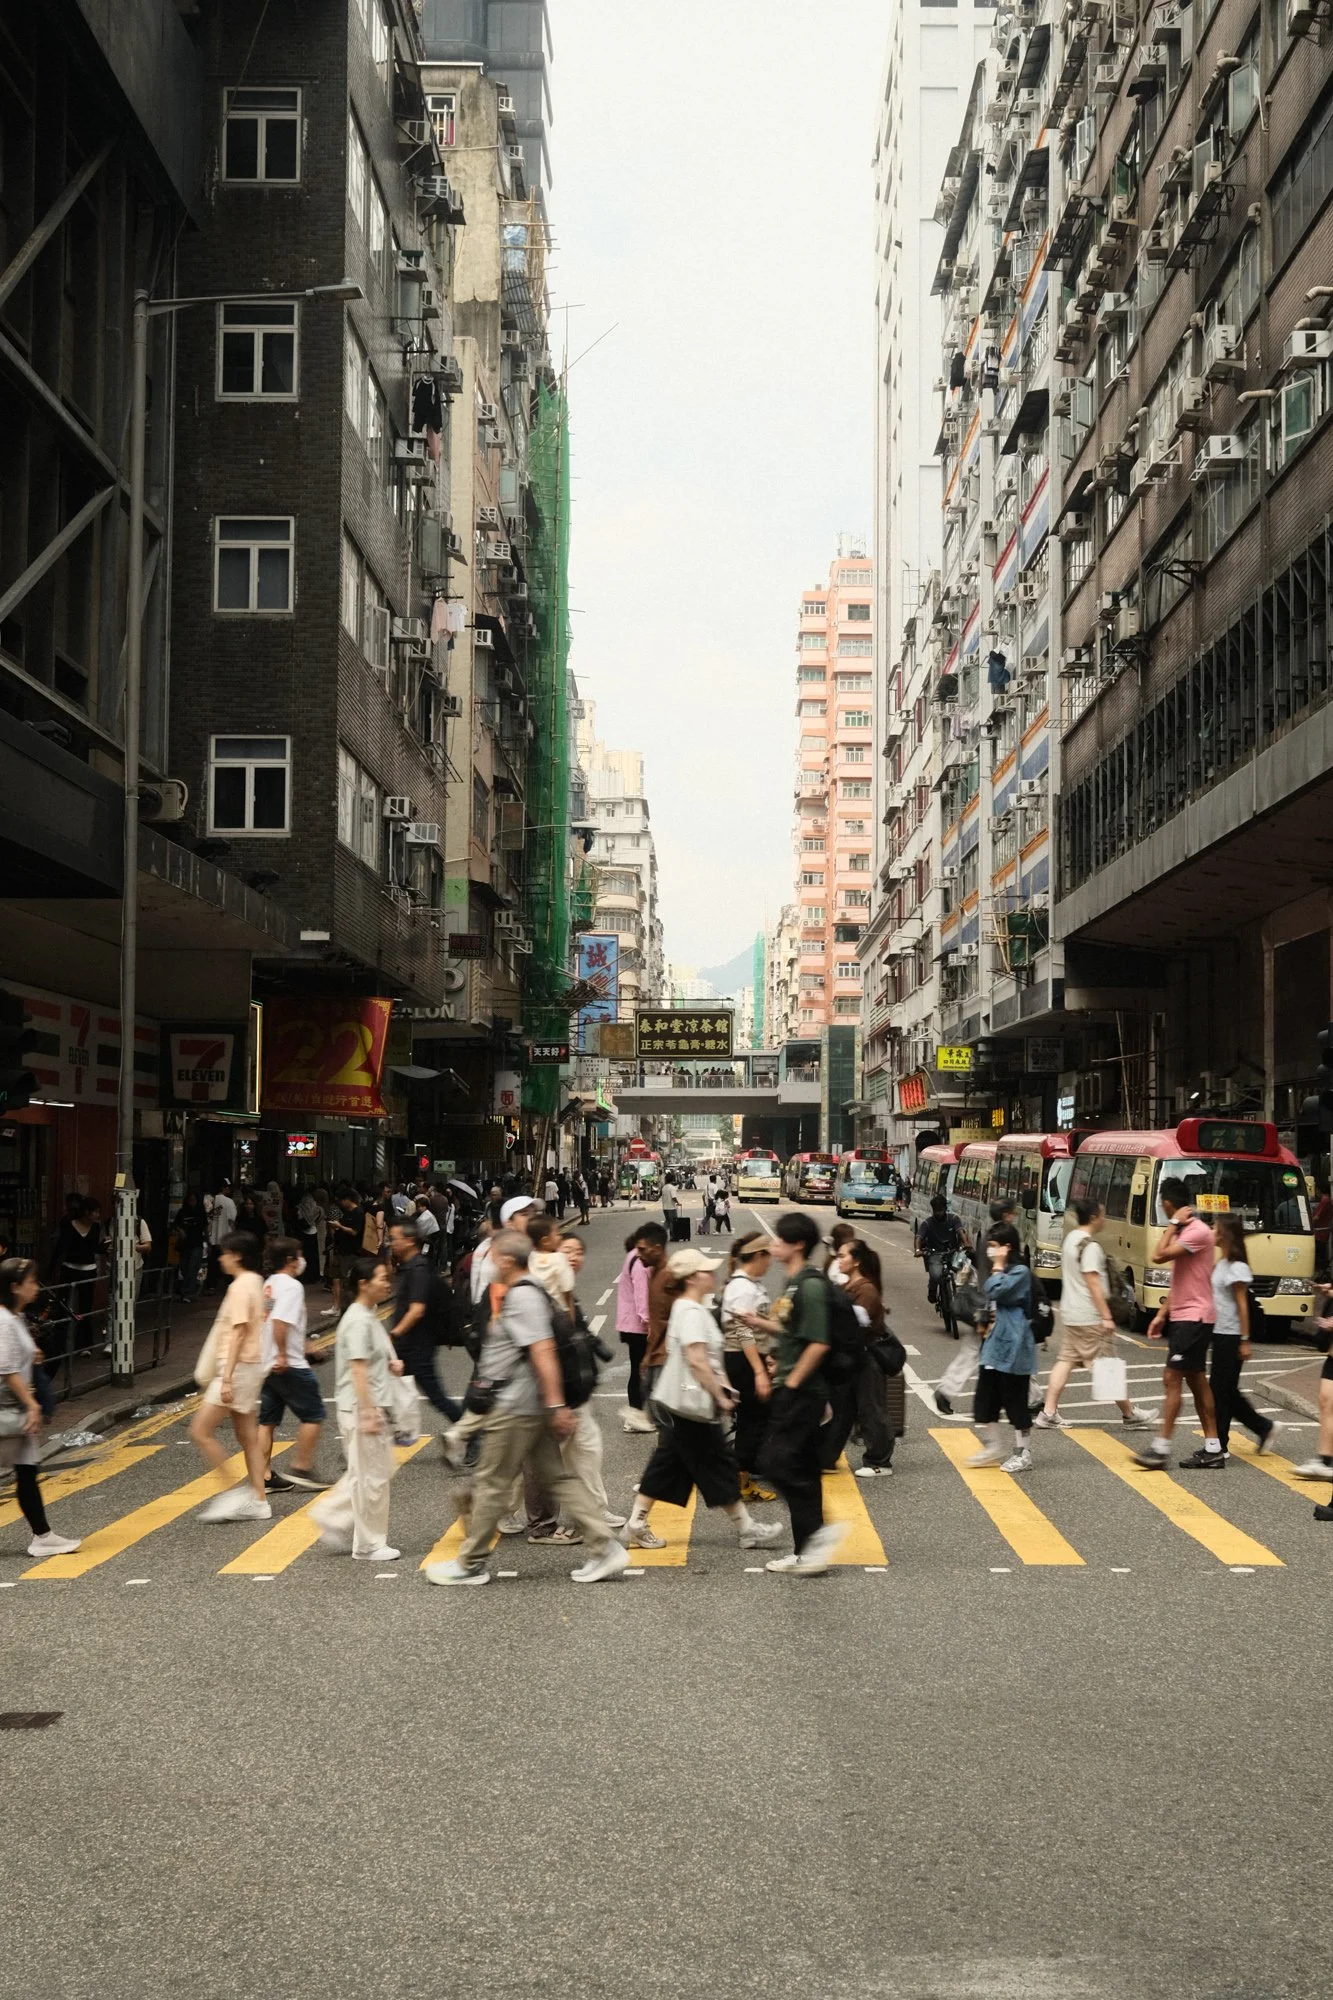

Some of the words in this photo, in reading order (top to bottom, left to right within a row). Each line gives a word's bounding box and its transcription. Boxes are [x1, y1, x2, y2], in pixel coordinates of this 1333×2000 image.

[271, 1020, 374, 1088] 22
[533, 1047, 560, 1057] 天天好
